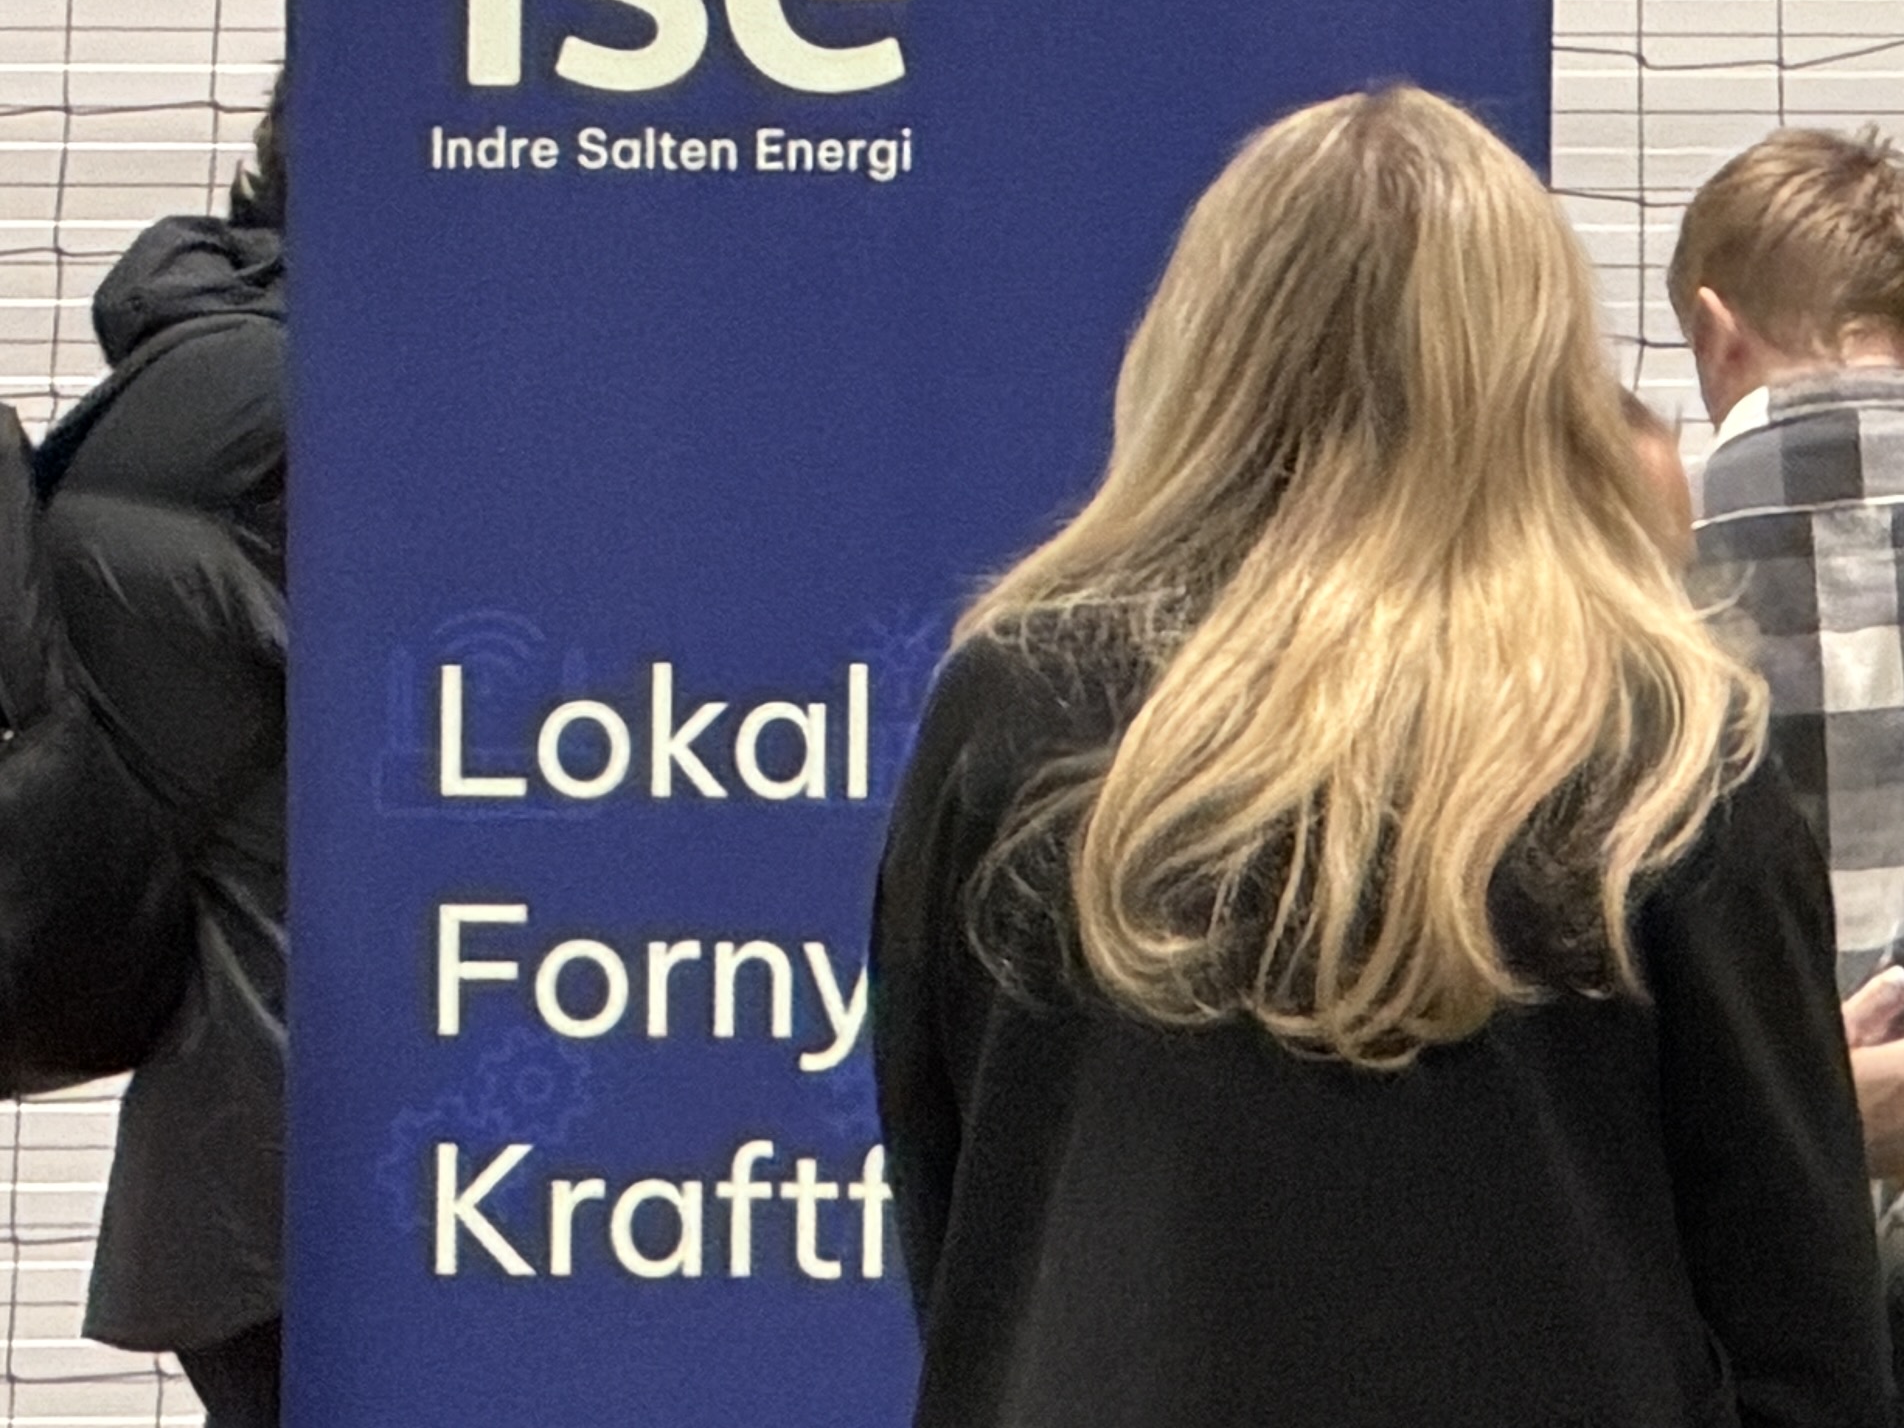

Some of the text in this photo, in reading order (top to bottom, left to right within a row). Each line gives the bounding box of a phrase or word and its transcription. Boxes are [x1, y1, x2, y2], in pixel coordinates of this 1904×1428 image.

[432, 126, 912, 182] Indre Salten Energi
[440, 662, 869, 800] Lokal
[437, 904, 868, 1072] Forny
